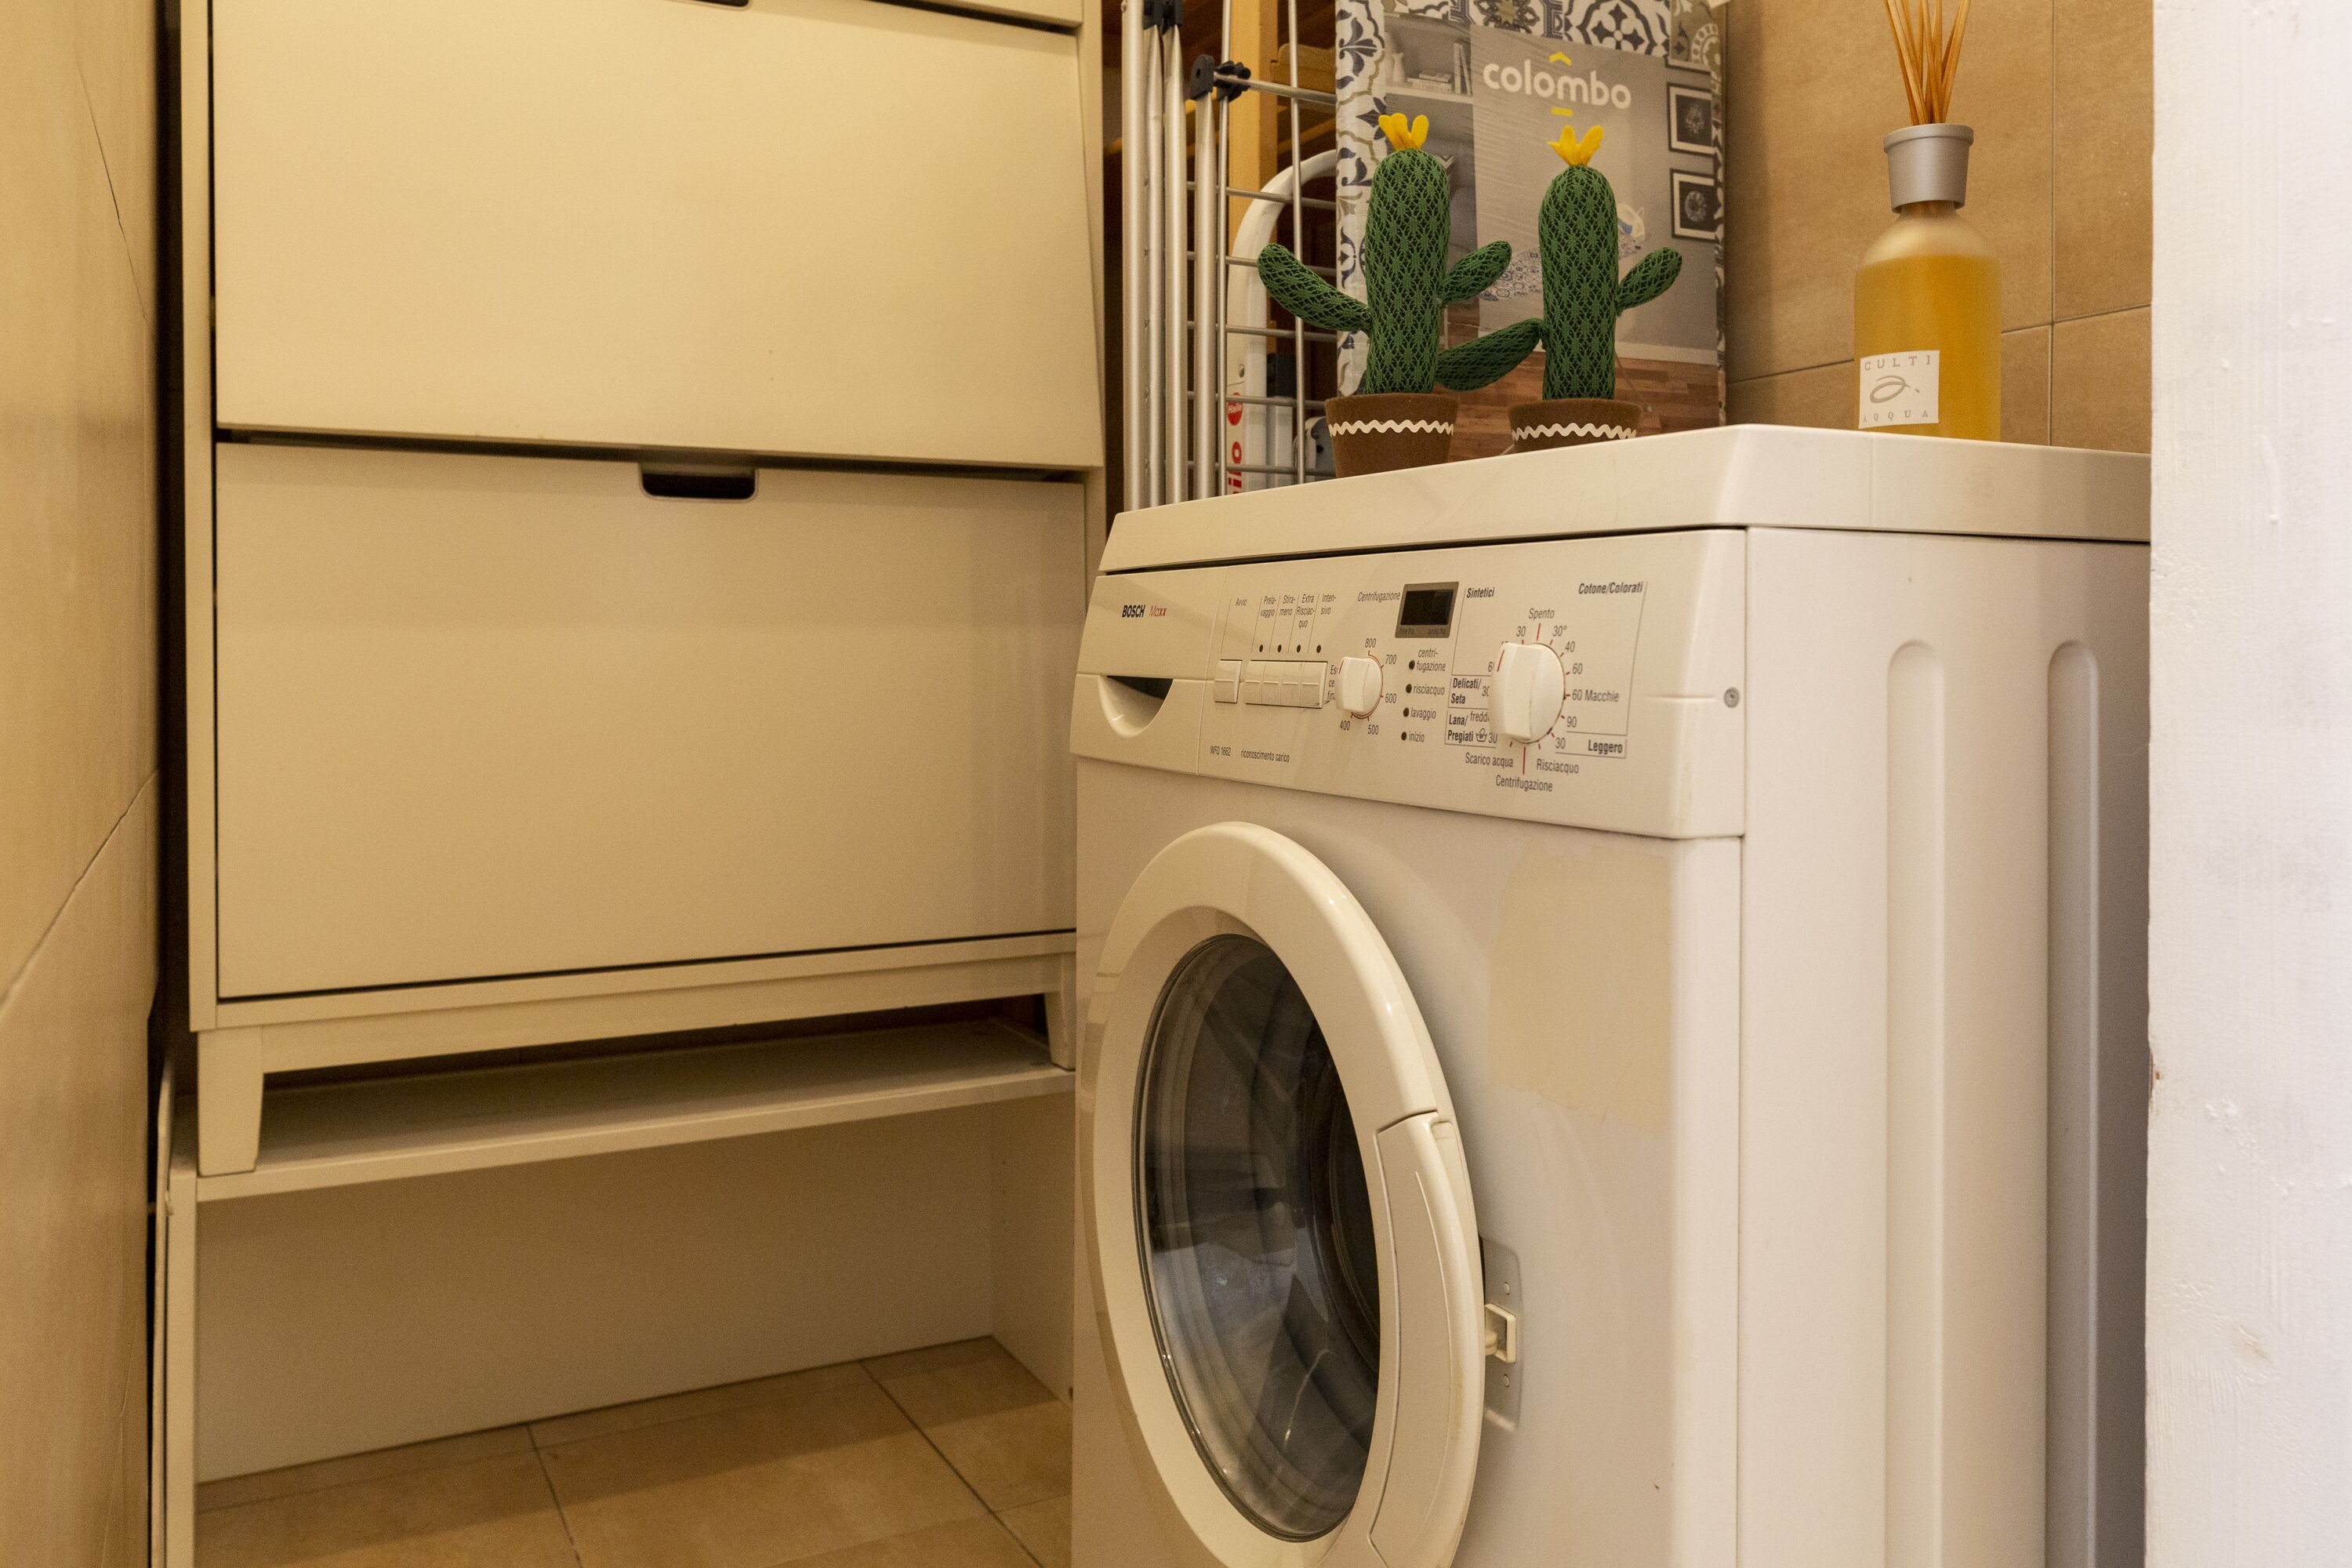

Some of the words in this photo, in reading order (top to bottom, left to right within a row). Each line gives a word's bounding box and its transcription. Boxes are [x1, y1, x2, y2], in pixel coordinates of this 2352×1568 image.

[1483, 59, 1632, 109] colombo
[1864, 354, 1931, 371] CULTI
[1863, 409, 1929, 423] AQQUA
[1467, 587, 1495, 598] Sintetici
[1578, 581, 1643, 594] Cotone/Colorati
[1235, 597, 1247, 606] Avvio
[1263, 596, 1277, 604] Prela-
[1283, 594, 1296, 604] Stira-
[1301, 593, 1315, 603] Extra
[1321, 593, 1337, 603] Inten-
[1358, 591, 1401, 603] Centrifugazione
[1122, 604, 1145, 618] BOSCH
[1149, 604, 1167, 617] Maxx
[1261, 608, 1275, 619] vaggio
[1320, 605, 1332, 615] sivo
[1528, 608, 1555, 621] Spento
[1298, 620, 1308, 630] quo
[1515, 626, 1526, 637] 30
[1365, 638, 1376, 648] 800
[1565, 641, 1576, 652] 40
[1417, 648, 1439, 658] centri-
[1385, 655, 1396, 665] 700
[1416, 660, 1446, 673] fugazione
[1572, 662, 1583, 674] 60
[1453, 677, 1482, 690] Delicati/
[1413, 684, 1446, 697] risciacquo
[1572, 689, 1582, 701] 60
[1584, 689, 1620, 702] Macchie
[1385, 693, 1396, 703] 600
[1450, 693, 1466, 704] Seta
[1410, 707, 1436, 720] lavaggio
[1340, 720, 1350, 731] 400
[1449, 714, 1468, 727] Lana/
[1566, 716, 1577, 728] 90
[1368, 724, 1379, 735] 500
[1408, 731, 1425, 742] inizio
[1447, 730, 1474, 743] Pregiati
[1555, 737, 1566, 749] 30
[1588, 739, 1624, 755] Leggero
[1240, 749, 1275, 760] riconoscimento
[1275, 753, 1290, 763] carico
[1465, 753, 1490, 765] Scarico
[1492, 756, 1513, 768] acqua
[1537, 758, 1580, 775] Risciacquo
[1495, 775, 1553, 792] Centrifugazione
